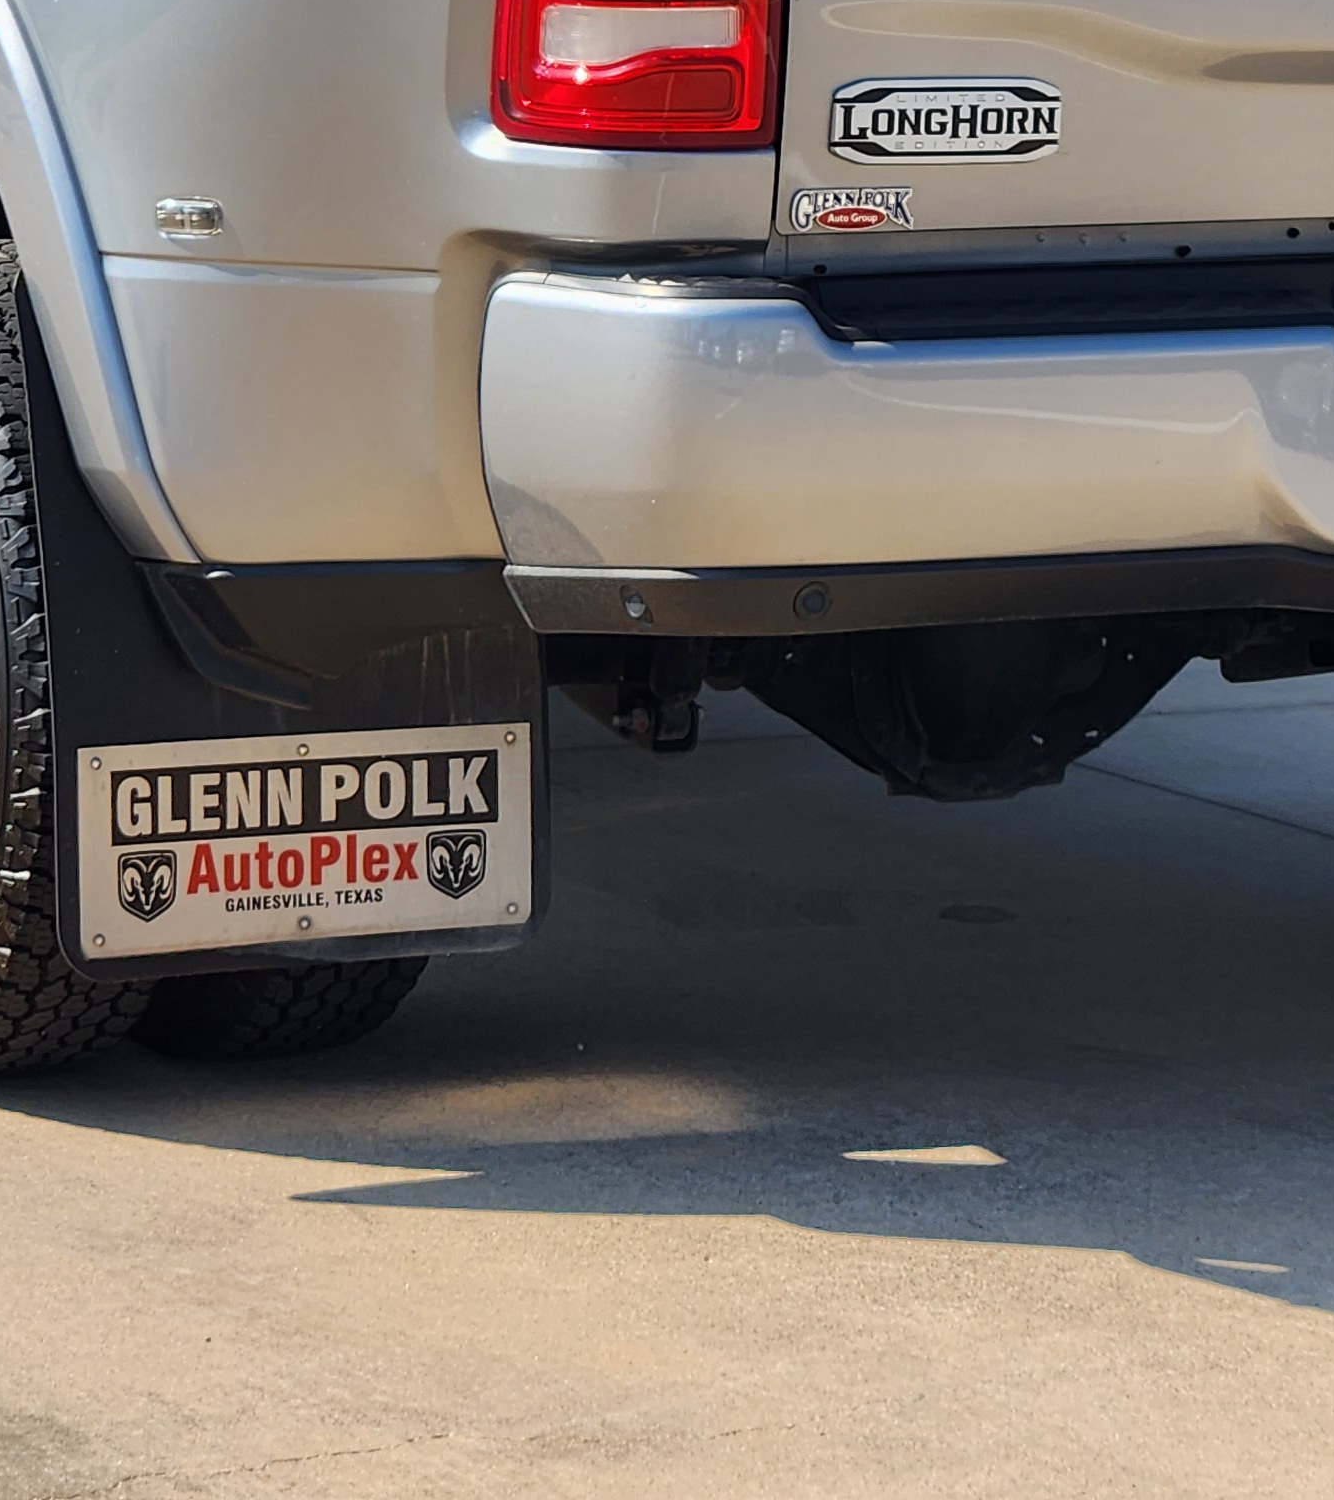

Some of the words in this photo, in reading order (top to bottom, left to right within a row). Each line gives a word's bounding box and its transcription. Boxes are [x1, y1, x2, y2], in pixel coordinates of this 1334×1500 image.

[896, 93, 1006, 102] LIMITED
[894, 140, 1004, 150] EDITION
[793, 190, 858, 230] GLENN
[863, 188, 913, 229] POLK
[827, 213, 849, 223] Auto
[851, 213, 878, 224] Group
[116, 767, 303, 838] GLENN
[320, 756, 489, 822] POLK
[186, 834, 419, 895] AutoPlex
[225, 893, 330, 913] GAINESVILLE,
[334, 888, 384, 906] TEXAS
